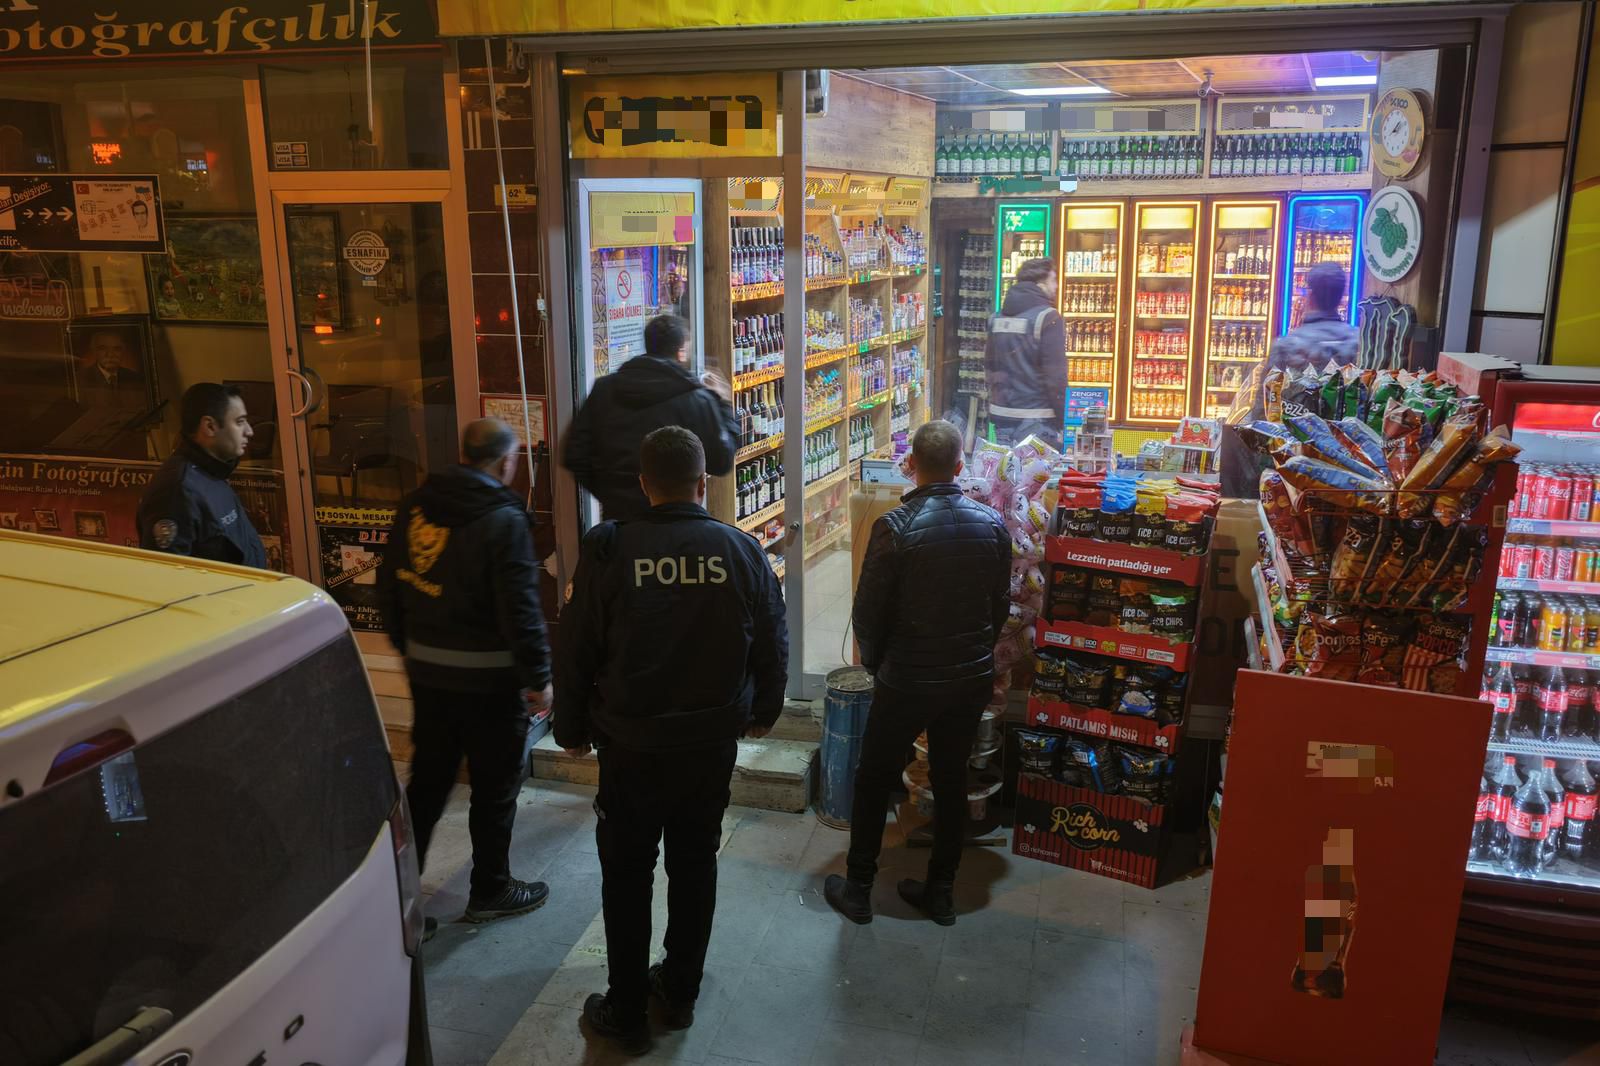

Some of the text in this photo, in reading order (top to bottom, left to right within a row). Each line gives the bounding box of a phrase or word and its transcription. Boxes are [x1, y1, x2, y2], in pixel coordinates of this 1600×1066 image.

[346, 248, 387, 257] ESNAFINA
[327, 511, 396, 521] SOSYAL MESAFE
[1067, 551, 1172, 575] Lezzetin patladığı yer
[1050, 806, 1096, 837] Rich
[1080, 826, 1121, 843] corn
